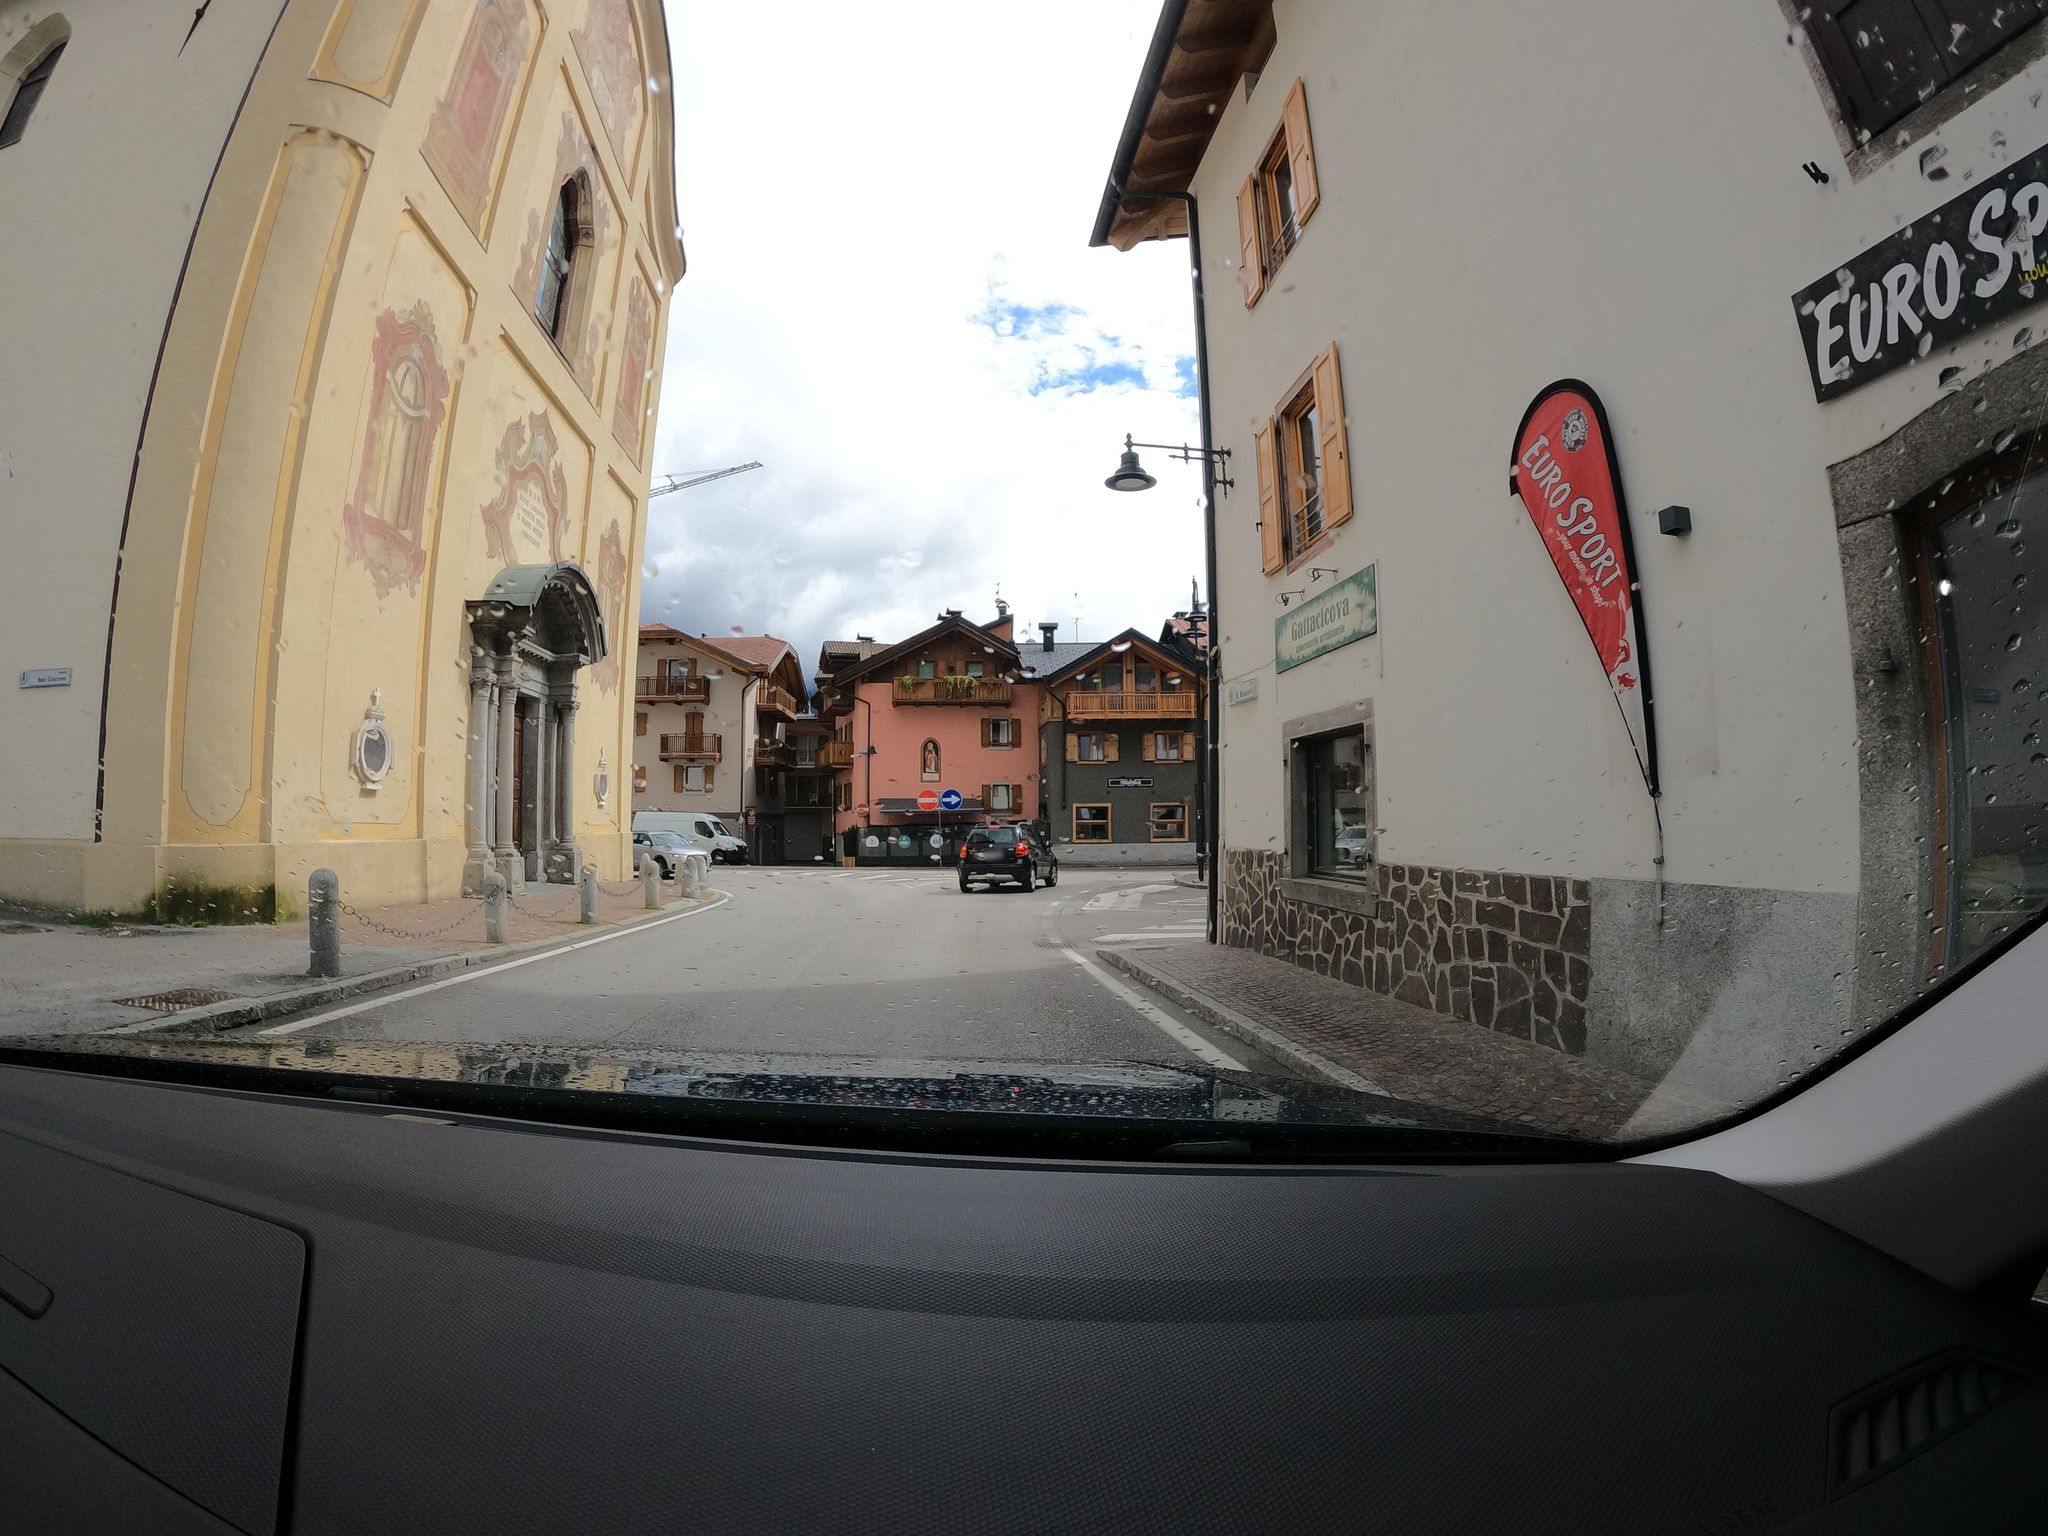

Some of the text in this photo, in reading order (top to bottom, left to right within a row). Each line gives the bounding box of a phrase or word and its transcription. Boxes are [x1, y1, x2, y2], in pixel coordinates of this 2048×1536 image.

[1814, 240, 1961, 385] EURO
[1522, 434, 1572, 509] EURO
[1556, 497, 1623, 588] SPORT
[1291, 597, 1350, 642] Gattacicova
